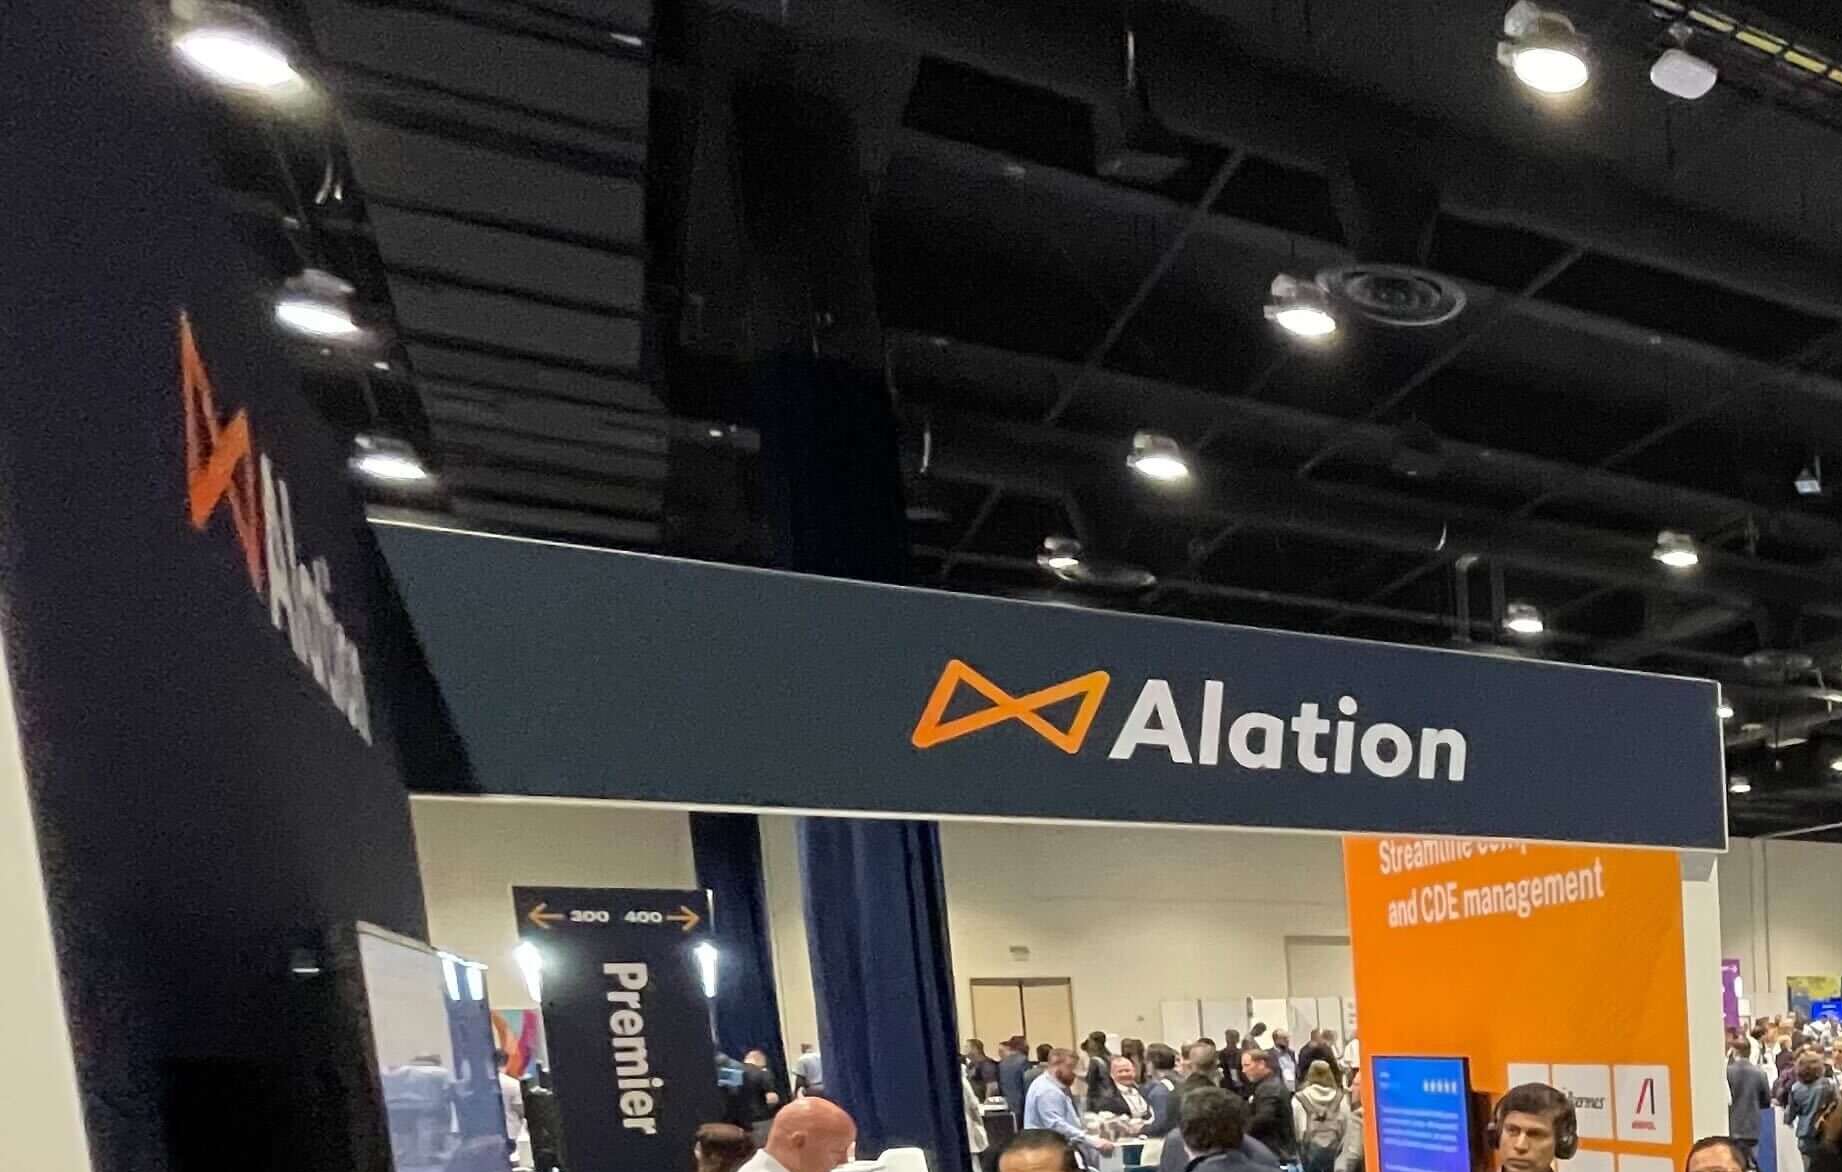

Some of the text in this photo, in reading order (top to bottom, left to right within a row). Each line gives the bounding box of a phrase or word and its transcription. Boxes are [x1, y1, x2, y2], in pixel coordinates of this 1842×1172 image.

[1109, 676, 1467, 782] Alation
[624, 911, 663, 924] 400
[1389, 857, 1605, 928] and CDE management
[603, 962, 664, 1135] Premier
